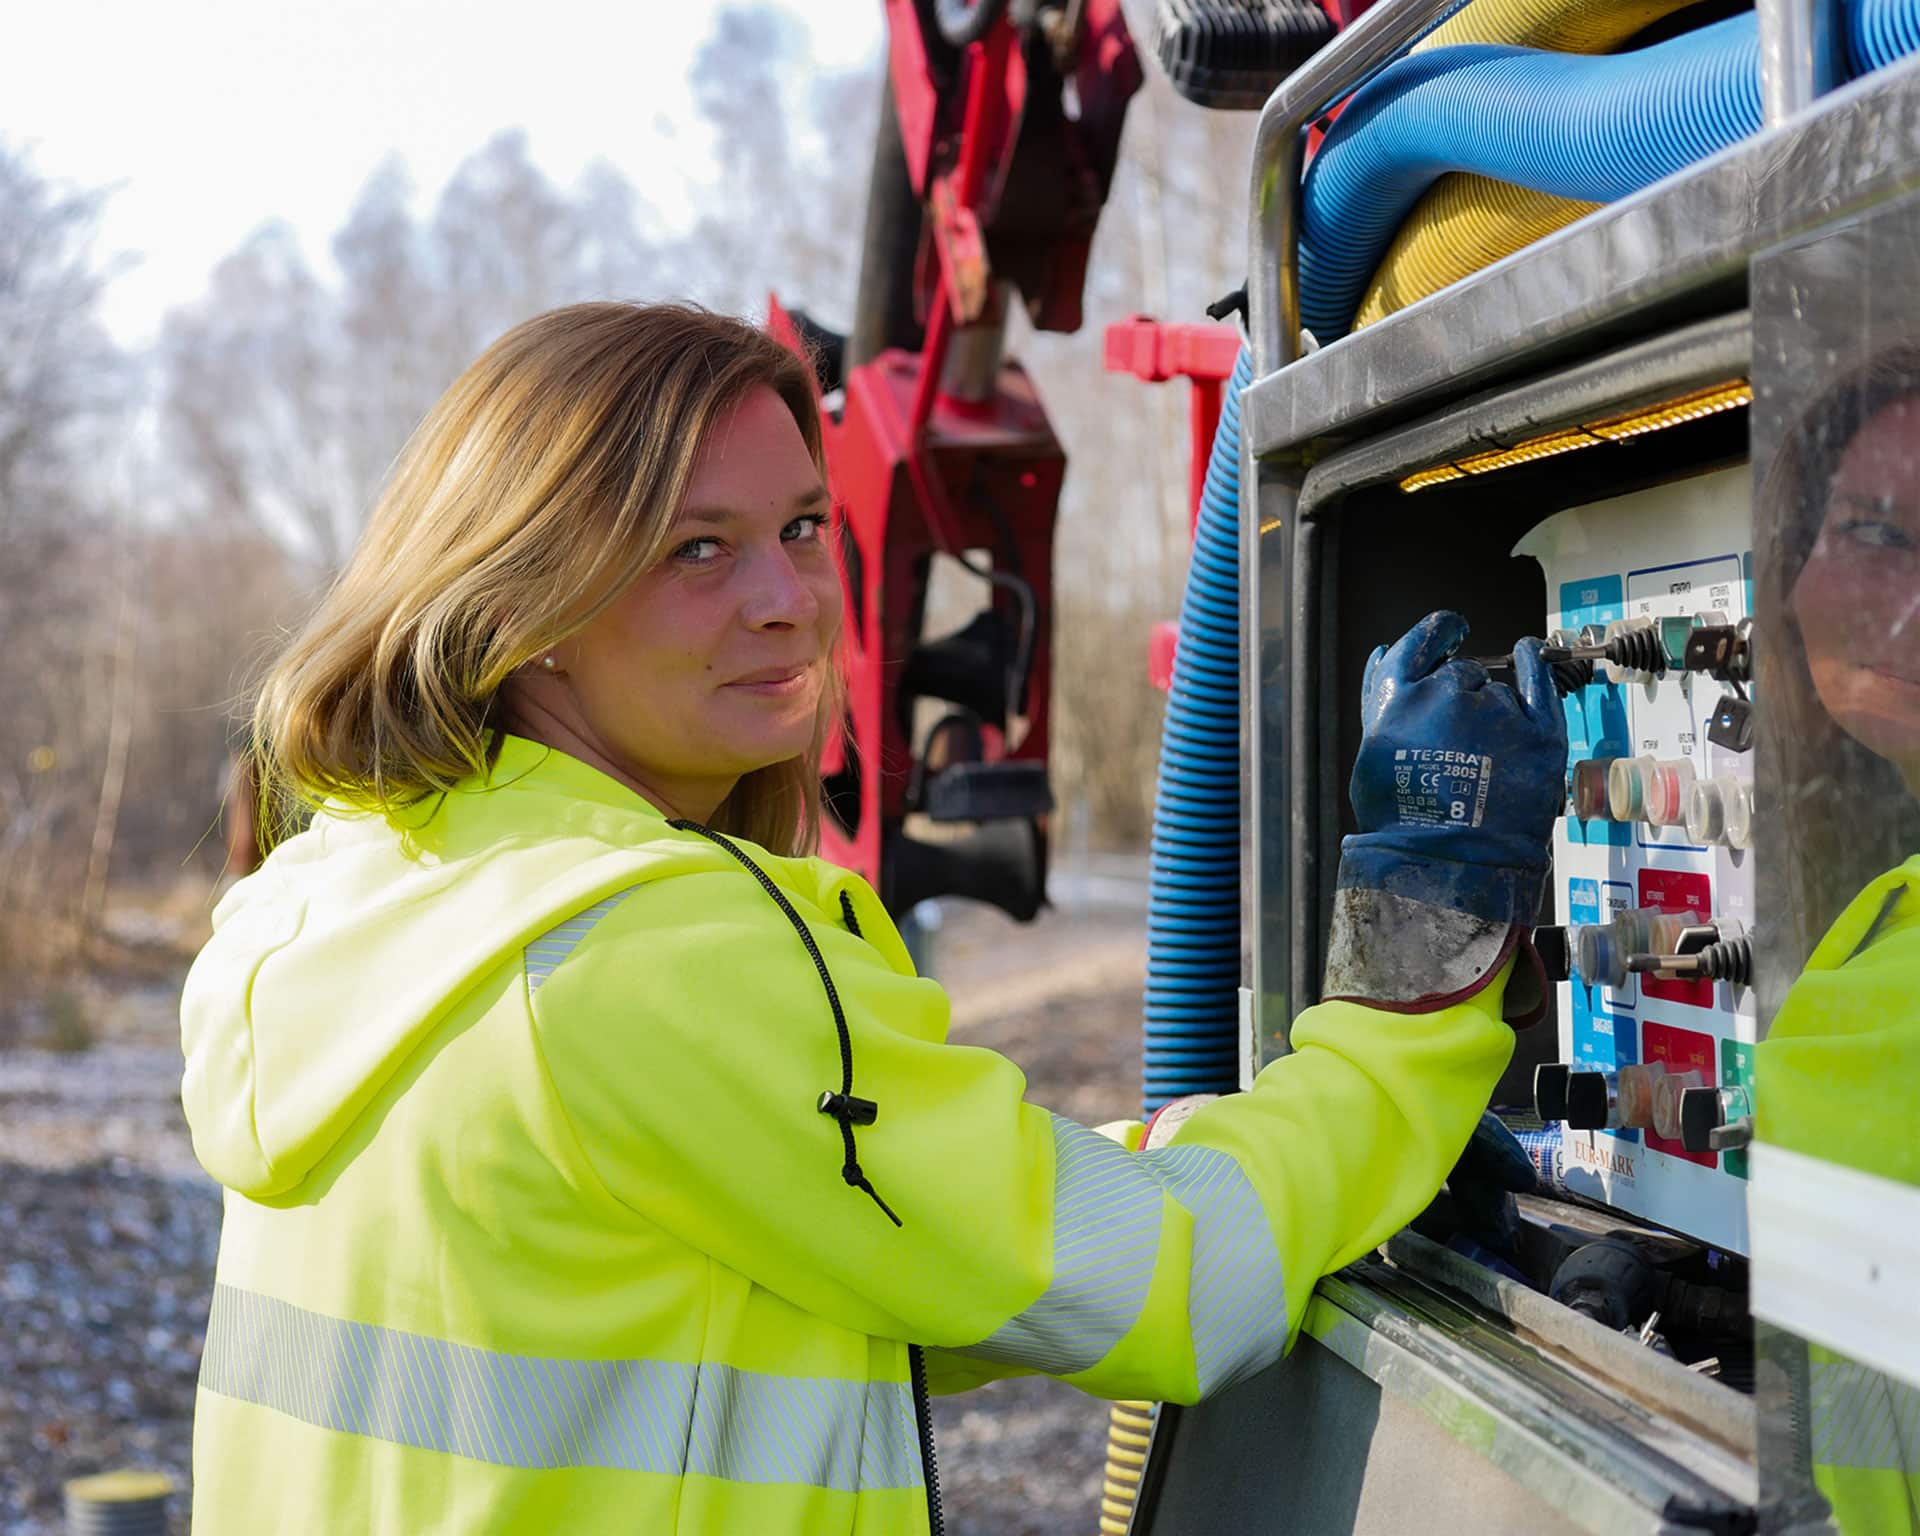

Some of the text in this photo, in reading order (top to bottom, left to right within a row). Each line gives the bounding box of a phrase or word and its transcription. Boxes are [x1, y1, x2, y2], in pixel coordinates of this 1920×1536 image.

[1420, 772, 1440, 787] CE
[1443, 764, 1478, 779] 2805
[1450, 800, 1465, 819] 8
[1575, 1141, 1635, 1178] EUR-MARK
